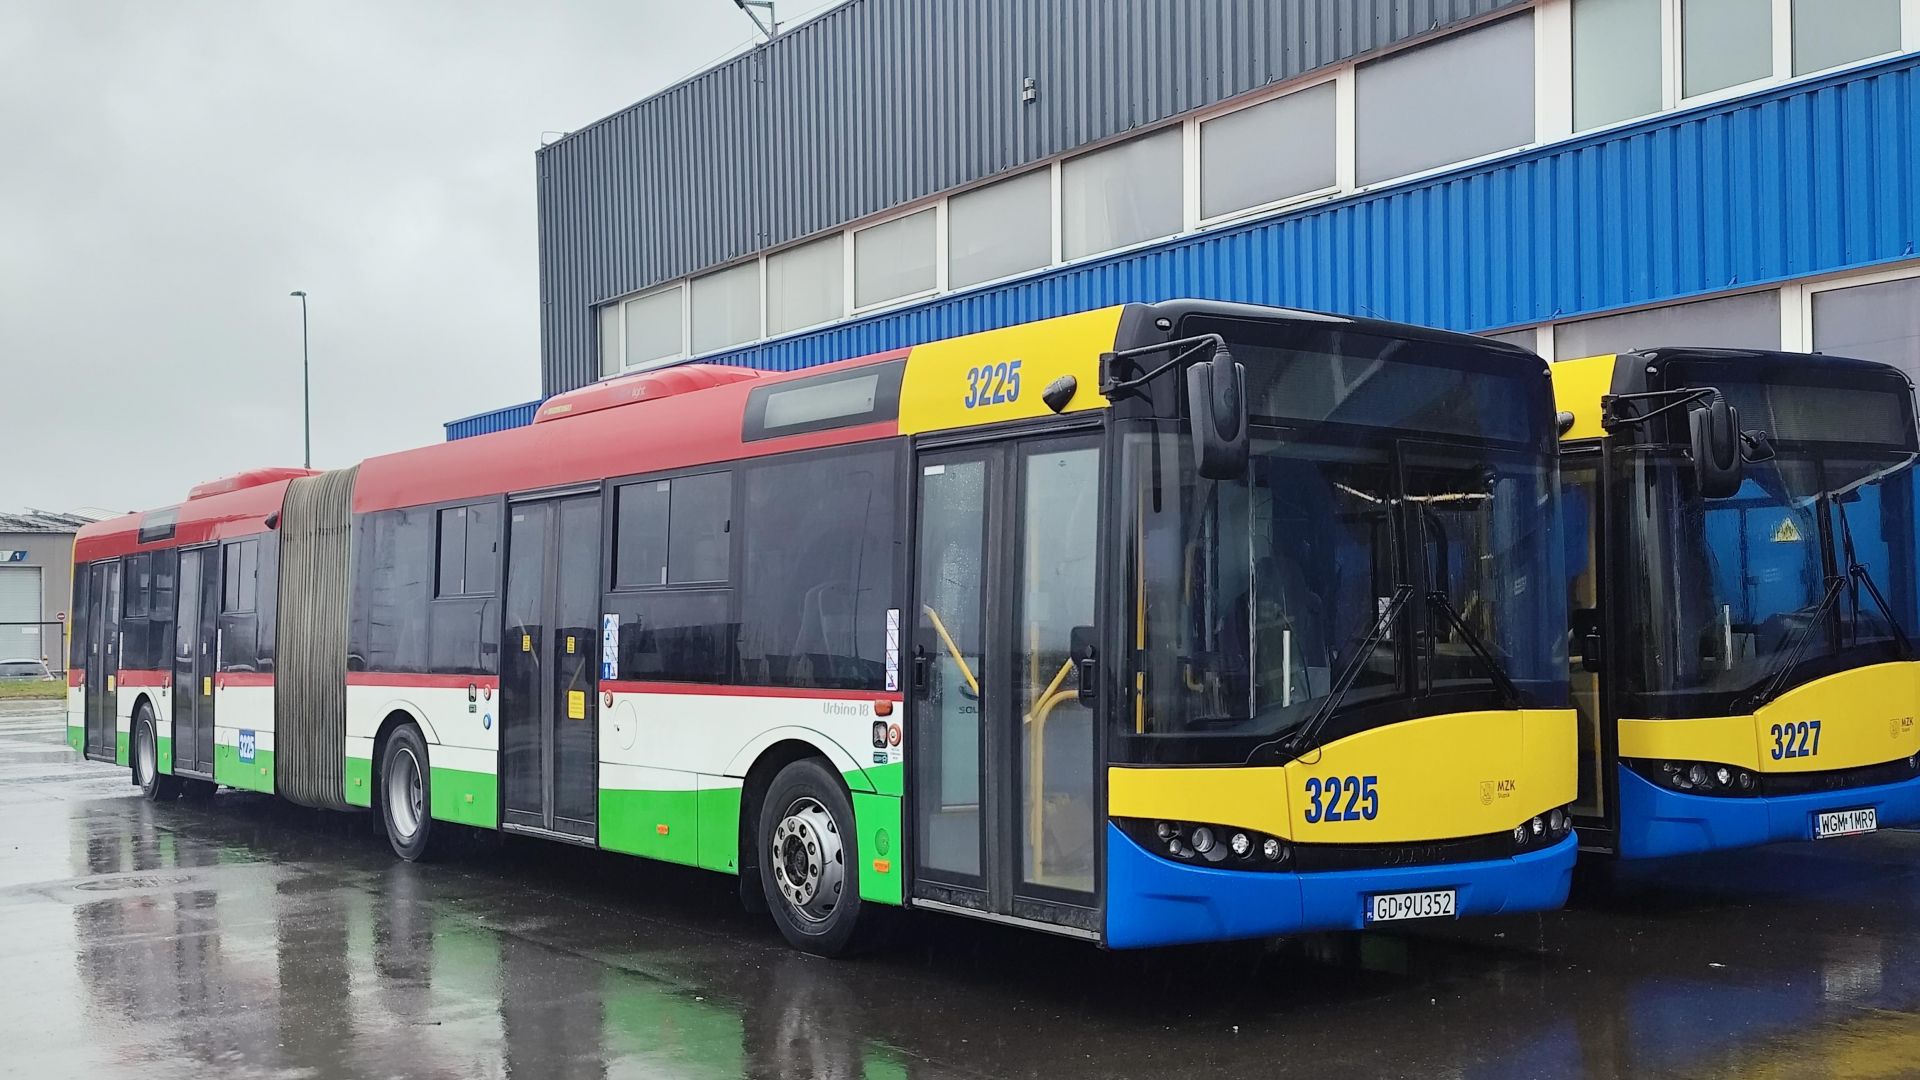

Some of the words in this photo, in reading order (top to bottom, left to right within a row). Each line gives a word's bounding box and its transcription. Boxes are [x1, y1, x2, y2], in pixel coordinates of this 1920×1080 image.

[965, 360, 1022, 409] 3225
[823, 702, 857, 716] Urbino
[859, 703, 869, 717] 18
[240, 734, 255, 760] 3225
[1771, 720, 1821, 760] 3227
[1497, 779, 1516, 791] MZK
[1304, 775, 1379, 824] 3225
[1821, 813, 1846, 834] WGM
[1849, 810, 1875, 830] 1MR9
[1377, 897, 1398, 919] GD
[1404, 893, 1452, 918] 9U352
